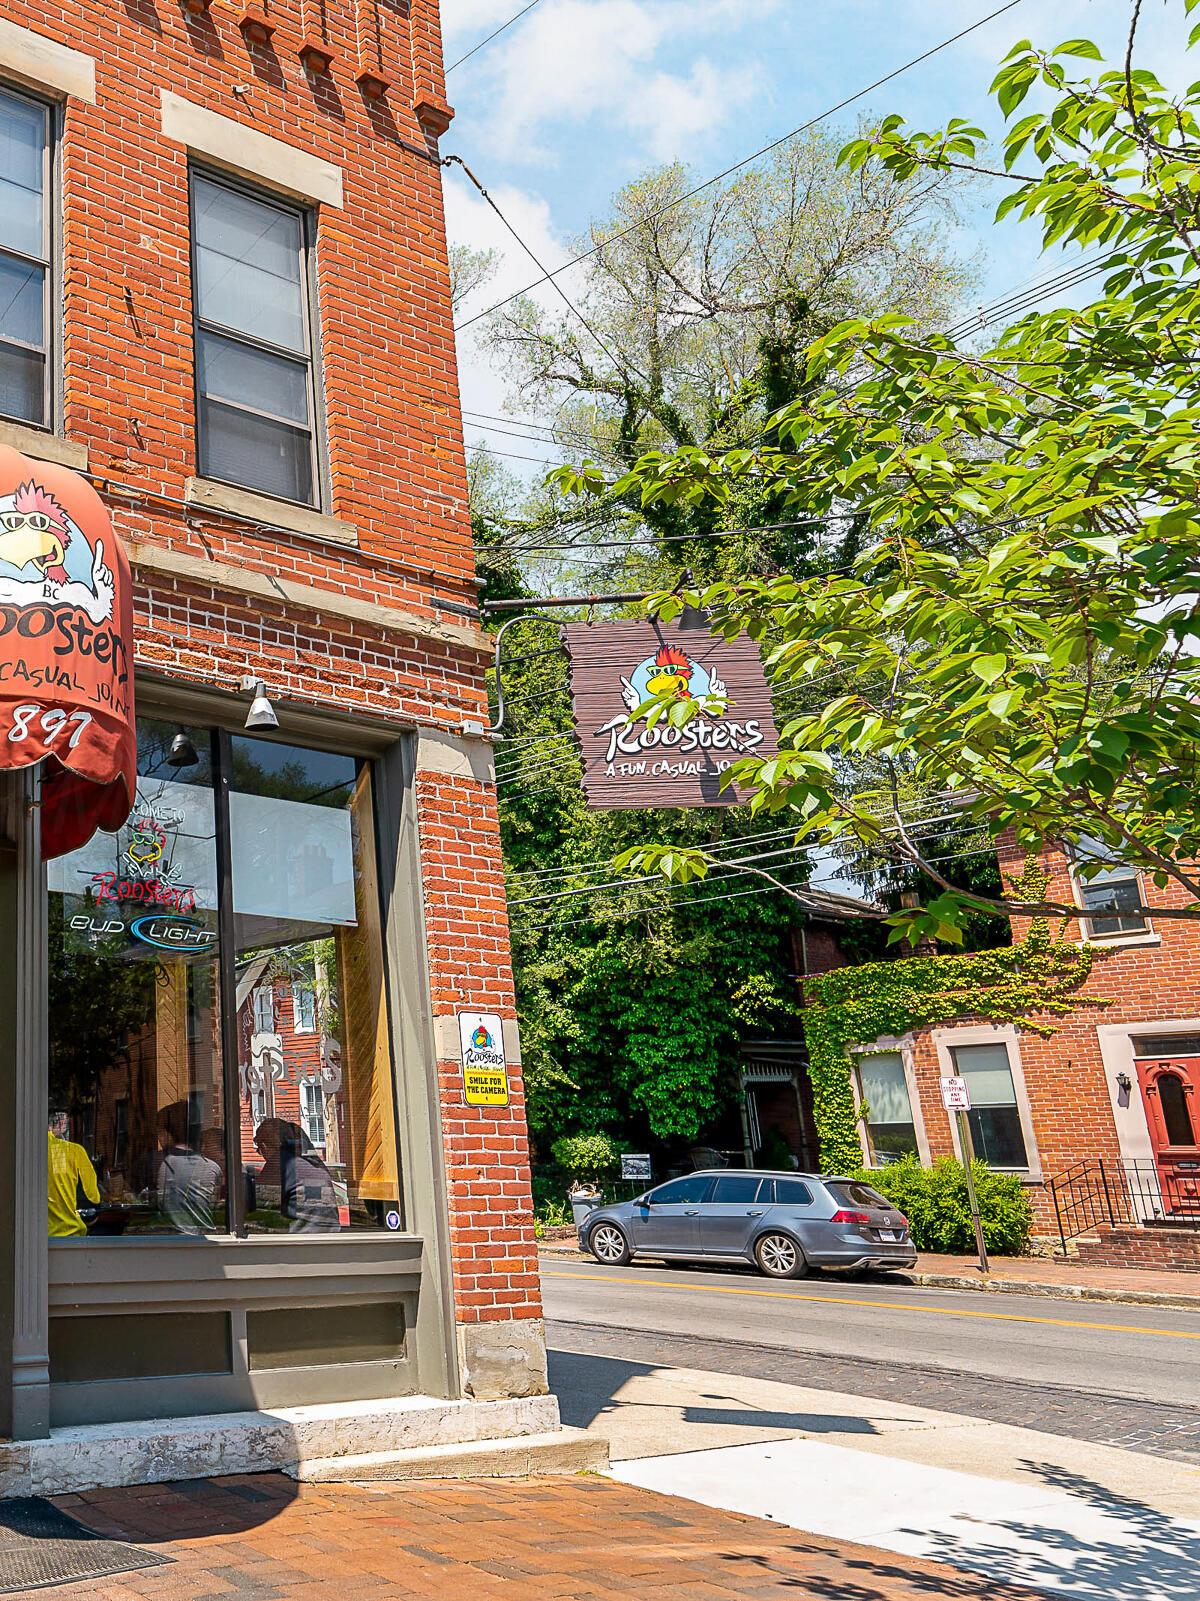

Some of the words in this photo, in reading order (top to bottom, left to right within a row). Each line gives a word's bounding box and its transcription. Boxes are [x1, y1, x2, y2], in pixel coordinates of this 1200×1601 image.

[43, 583, 60, 600] BC
[7, 704, 92, 748] 897
[593, 713, 764, 762] Roosters
[603, 763, 616, 777] A
[652, 759, 707, 778] CASUAL
[92, 871, 196, 912] Roosters
[70, 915, 125, 933] BUD
[150, 923, 217, 943] LIGHT
[464, 1048, 504, 1065] Roosters
[467, 1085, 479, 1094] THE
[480, 1086, 506, 1095] CAMERA
[469, 1076, 488, 1085] SMILE
[490, 1077, 502, 1086] FOR
